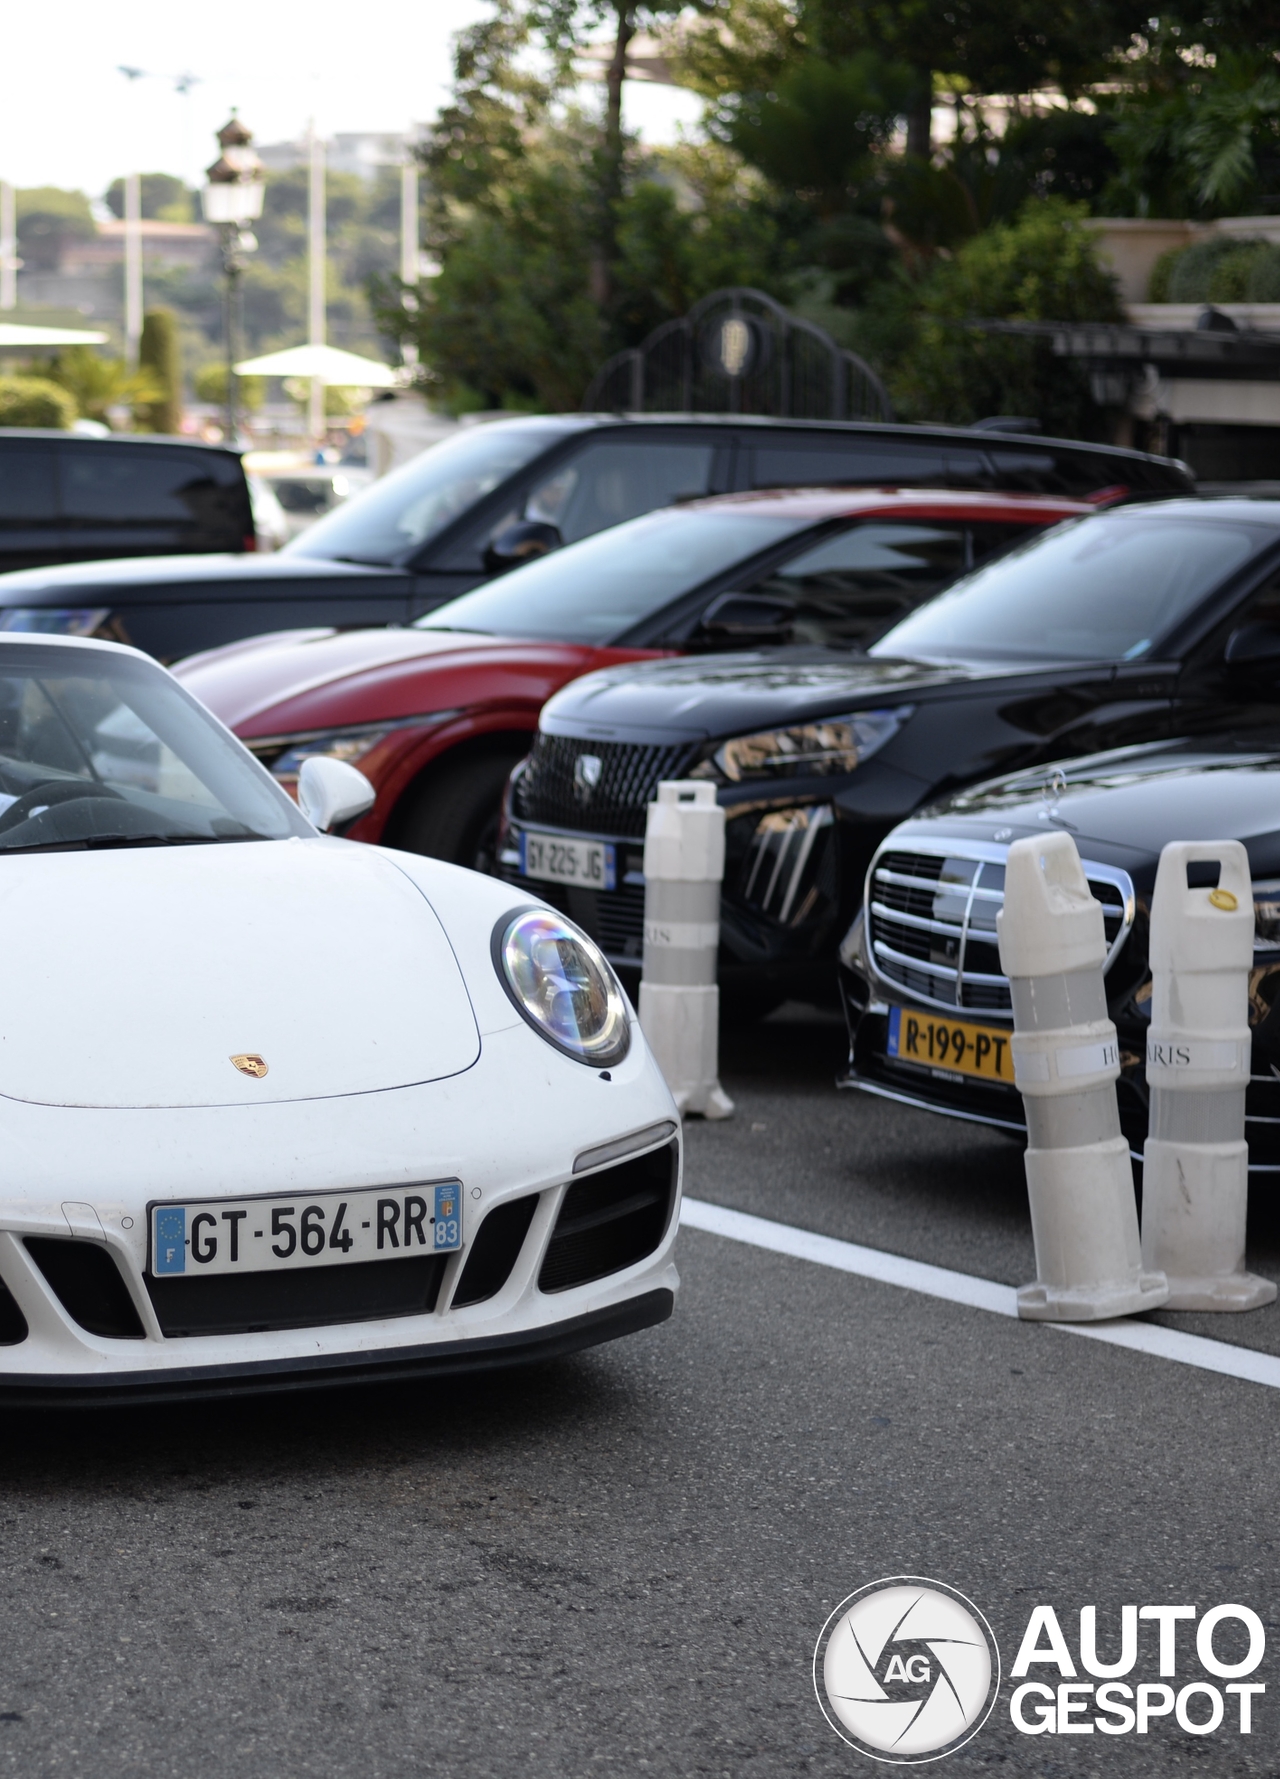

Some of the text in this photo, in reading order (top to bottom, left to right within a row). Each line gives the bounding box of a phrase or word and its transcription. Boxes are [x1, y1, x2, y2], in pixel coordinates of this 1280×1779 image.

[527, 840, 602, 881] GY-225-JG
[906, 1017, 1007, 1075] R-199-PT
[190, 1195, 427, 1264] GT-564-RR
[436, 1220, 458, 1245] 83
[166, 1248, 176, 1263] F
